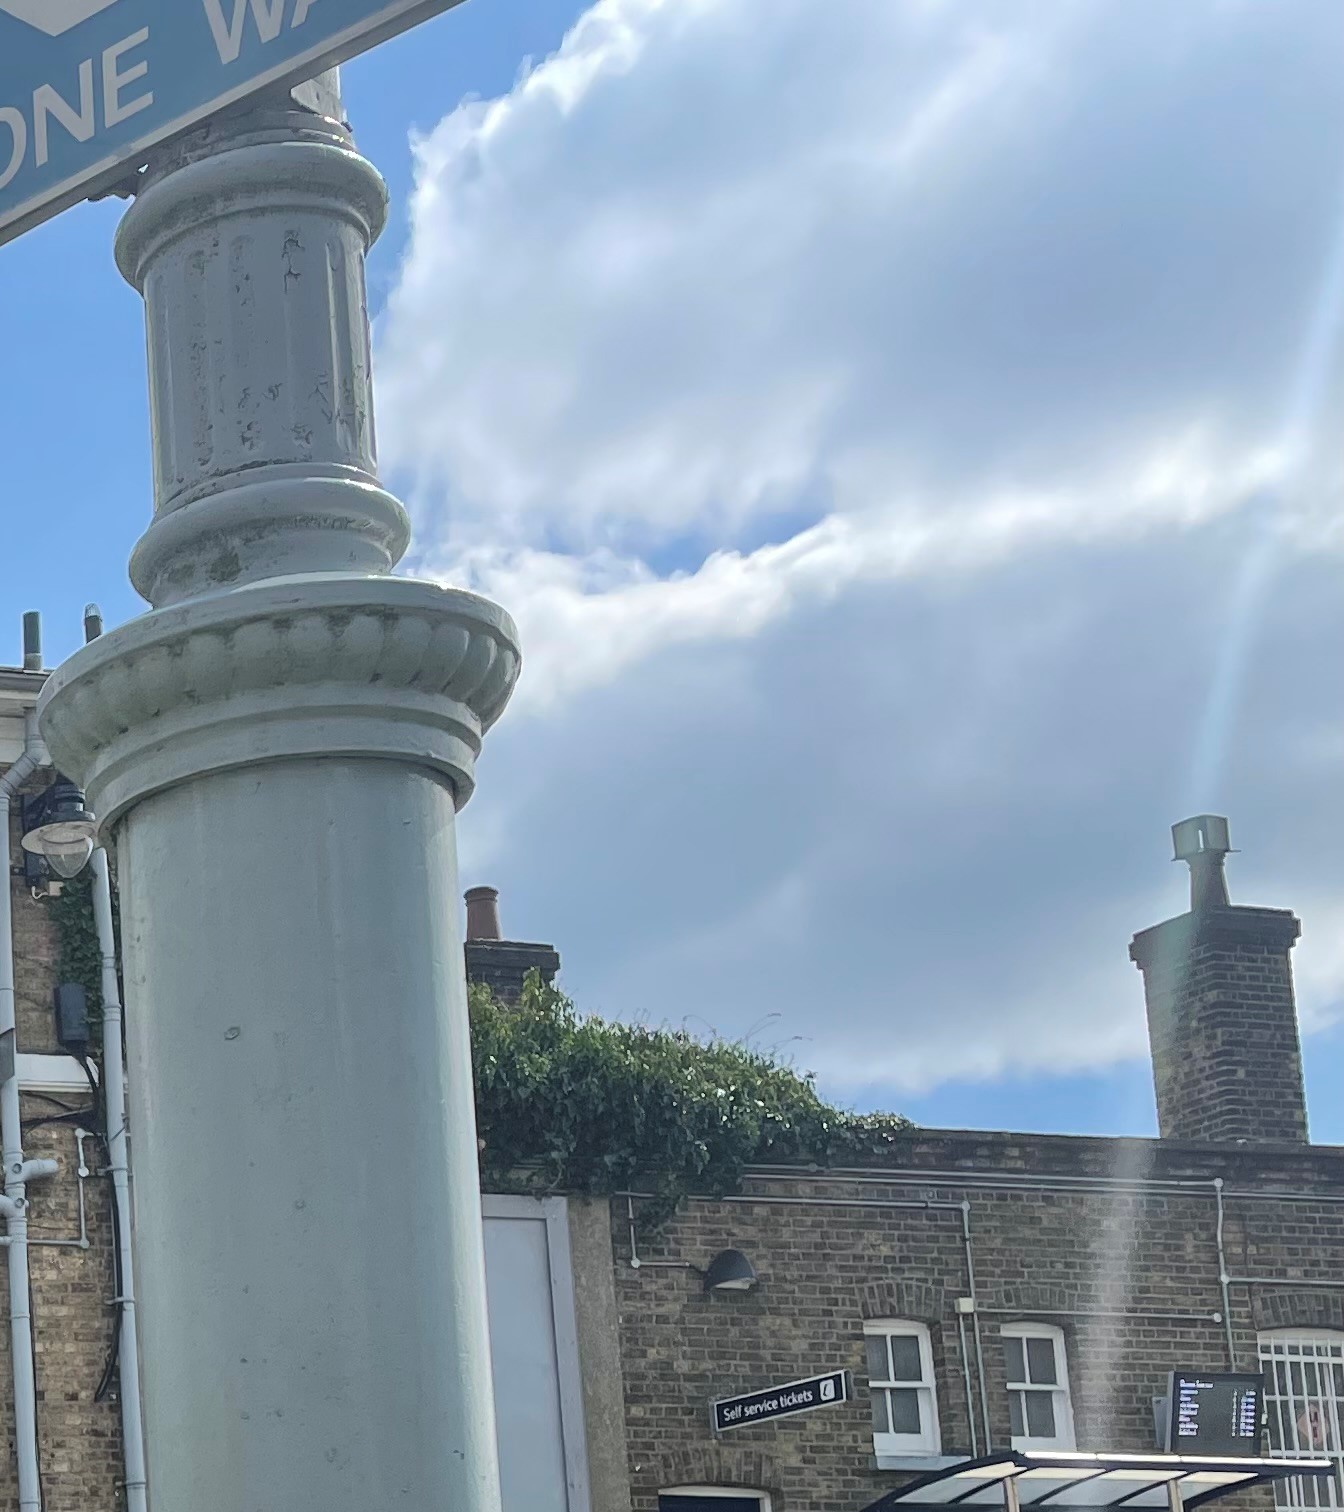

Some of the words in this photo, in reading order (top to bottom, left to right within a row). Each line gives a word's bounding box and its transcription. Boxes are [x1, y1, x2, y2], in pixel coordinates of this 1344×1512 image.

[202, 0, 313, 65] W
[723, 1404, 743, 1421] Self
[744, 1399, 779, 1416] service
[780, 1390, 813, 1407] tickets
